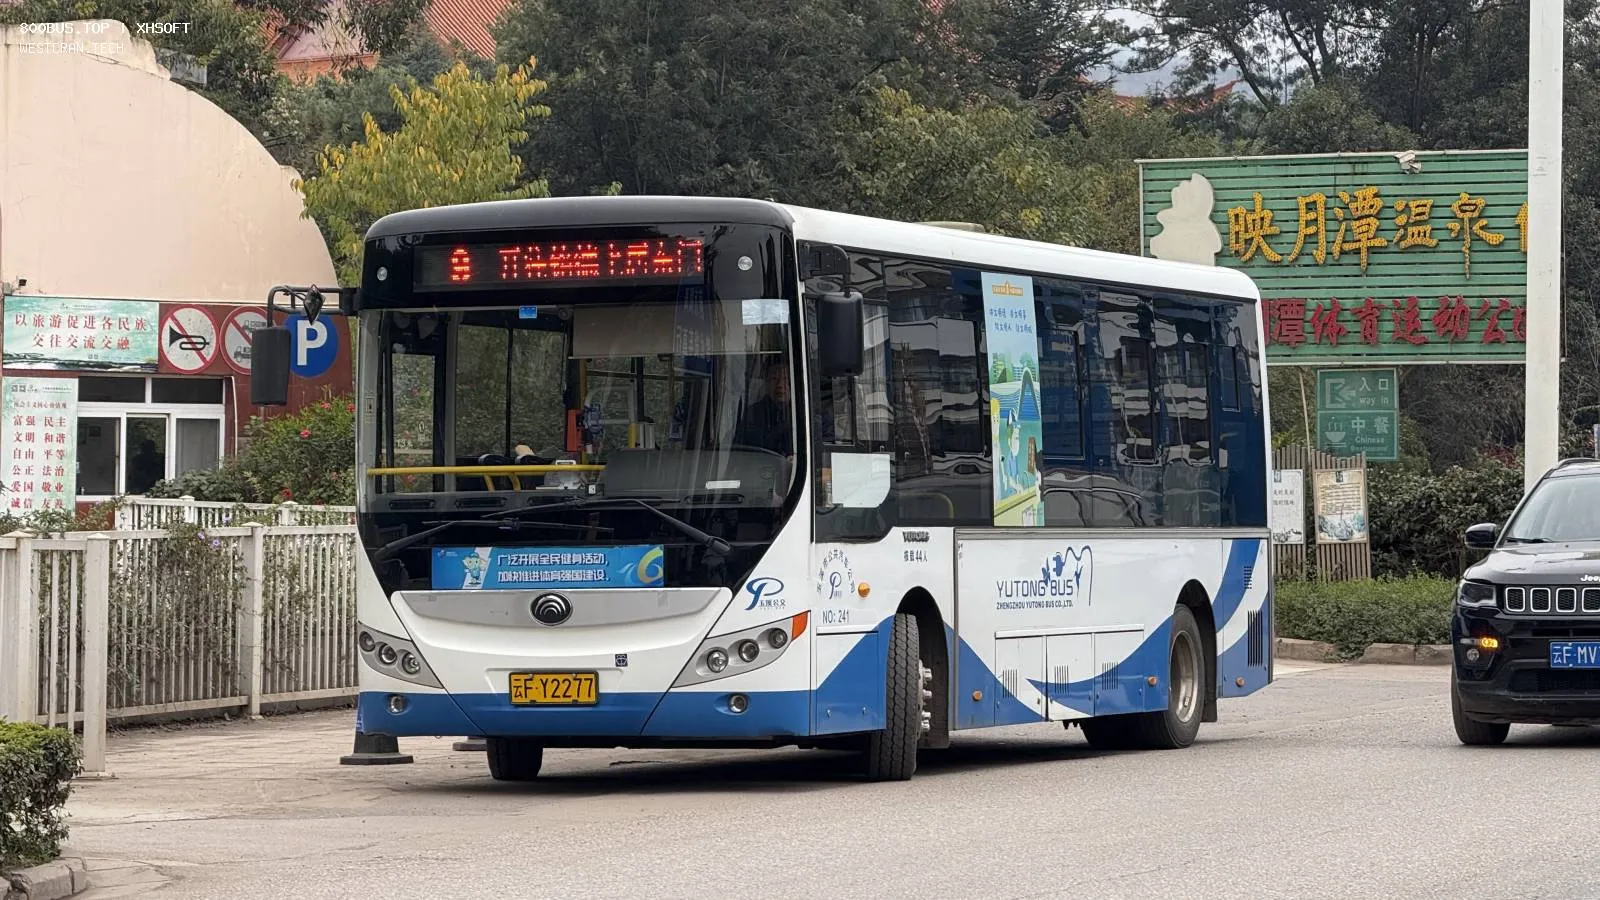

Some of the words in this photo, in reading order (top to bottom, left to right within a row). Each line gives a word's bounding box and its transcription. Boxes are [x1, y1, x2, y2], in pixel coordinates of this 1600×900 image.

[1227, 186, 1527, 280] 映月潭温泉
[15, 311, 147, 332] 以旅游促进各民族
[1261, 293, 1526, 348] 潭体育运动公
[32, 333, 131, 351] 交往交流交融
[297, 319, 328, 366] P
[1359, 376, 1389, 392] 入口
[44, 415, 67, 428] 民主
[1351, 416, 1390, 435] 中餐
[13, 447, 34, 460] 自由
[12, 464, 35, 476] 公正
[996, 579, 1046, 598] YUTONG
[1050, 579, 1074, 596] BUS
[996, 601, 1025, 610] ZHENGZHOU
[1025, 601, 1045, 609] YUTONG
[1045, 600, 1055, 608] BUS
[838, 609, 850, 623] 241
